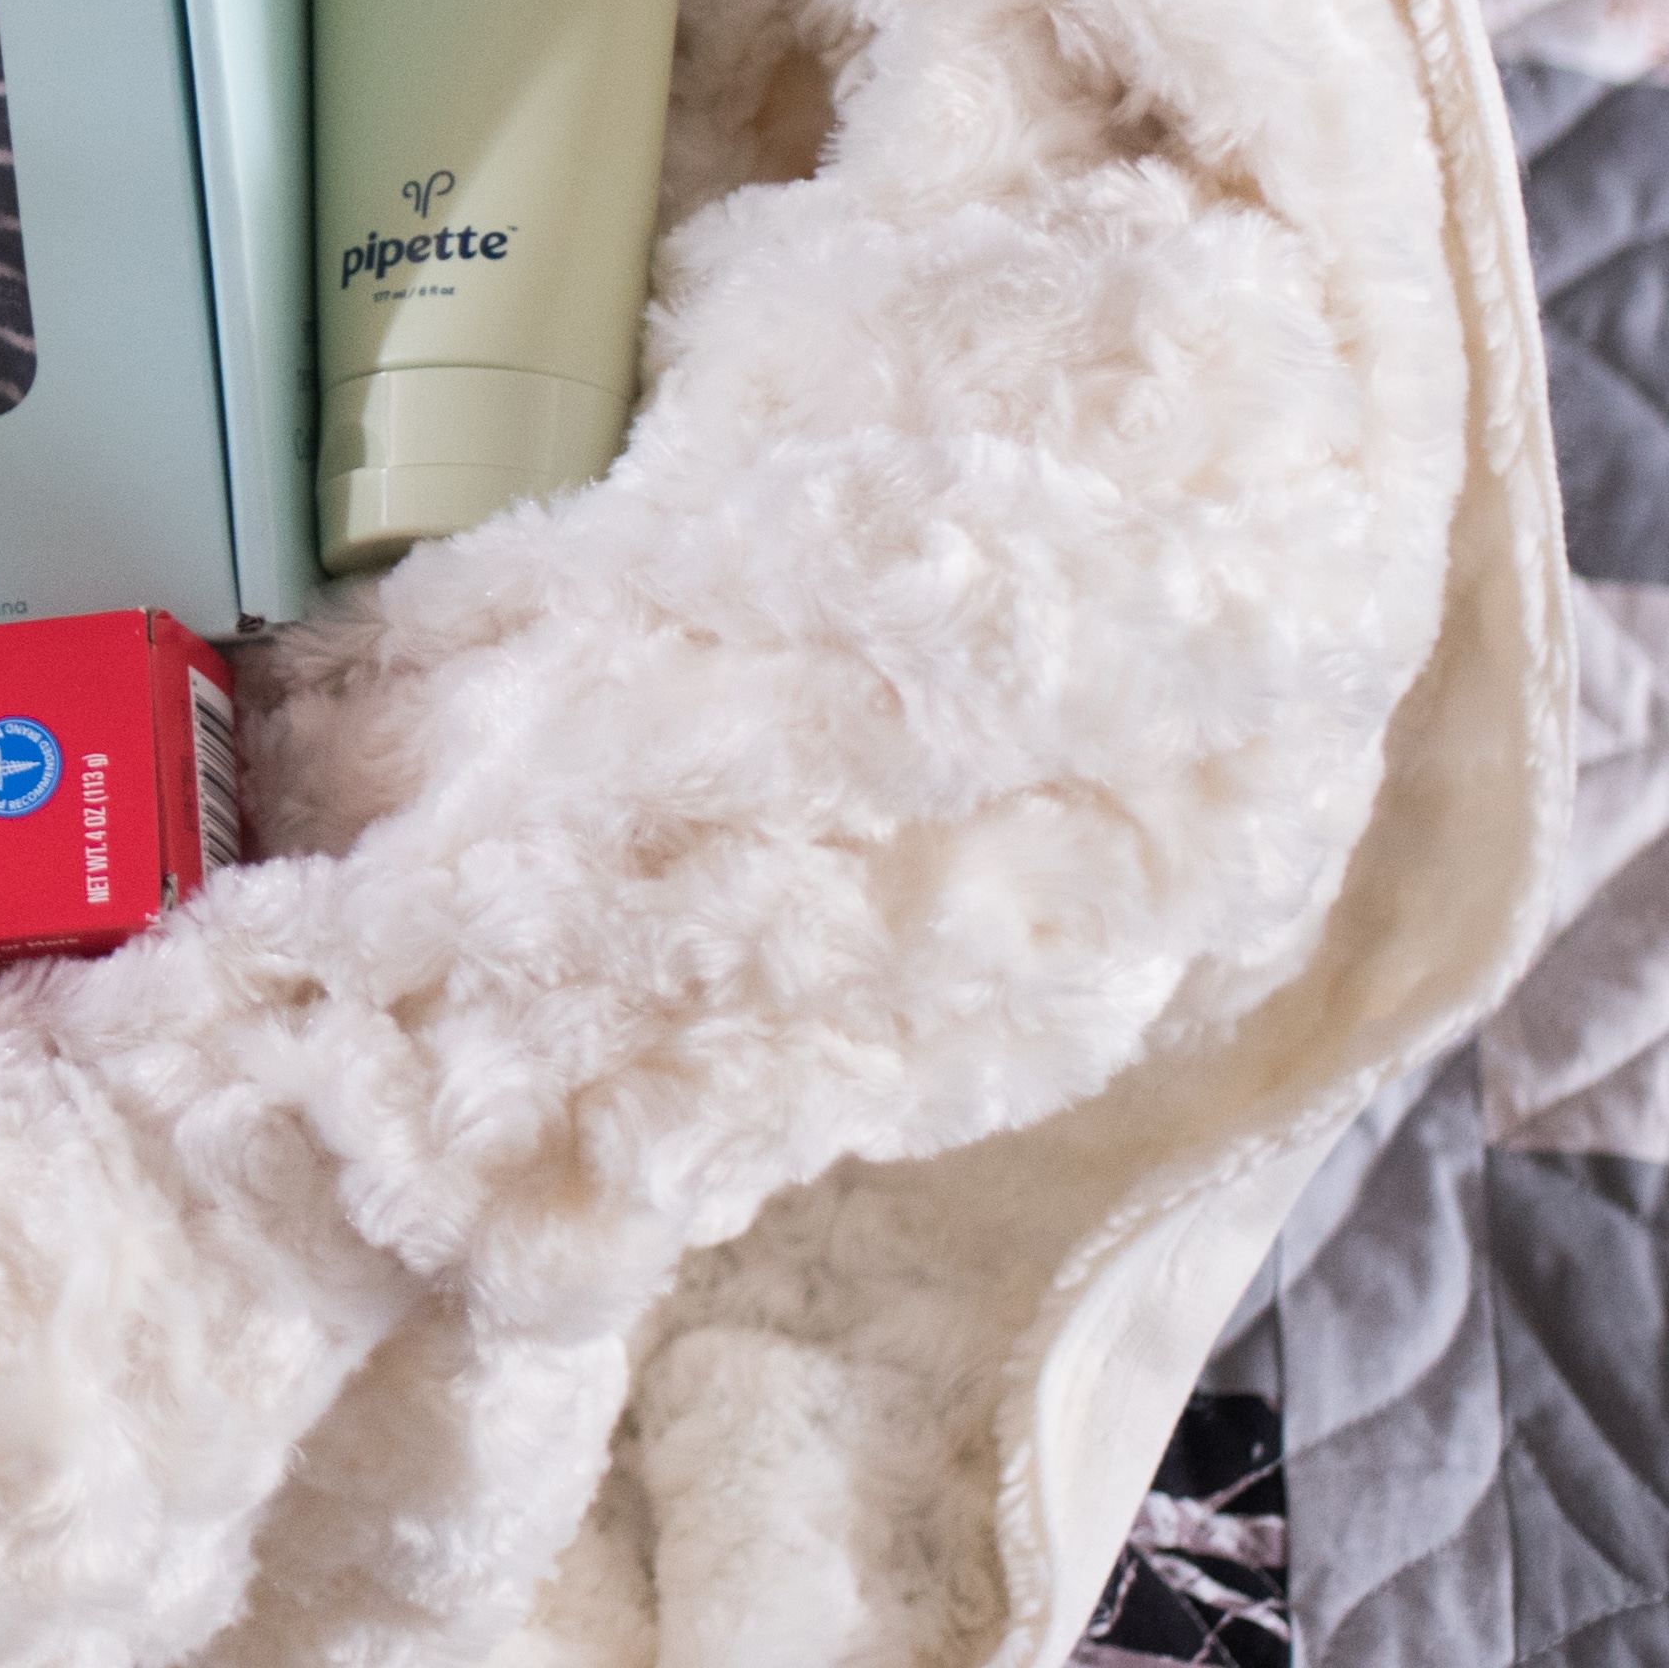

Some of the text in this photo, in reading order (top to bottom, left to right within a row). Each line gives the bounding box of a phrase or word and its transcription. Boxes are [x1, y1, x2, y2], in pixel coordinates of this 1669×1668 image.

[340, 225, 509, 290] pipette
[9, 740, 56, 810] RECOMMENDED
[82, 753, 110, 903] NET WT. 4 OZ (113 g)
